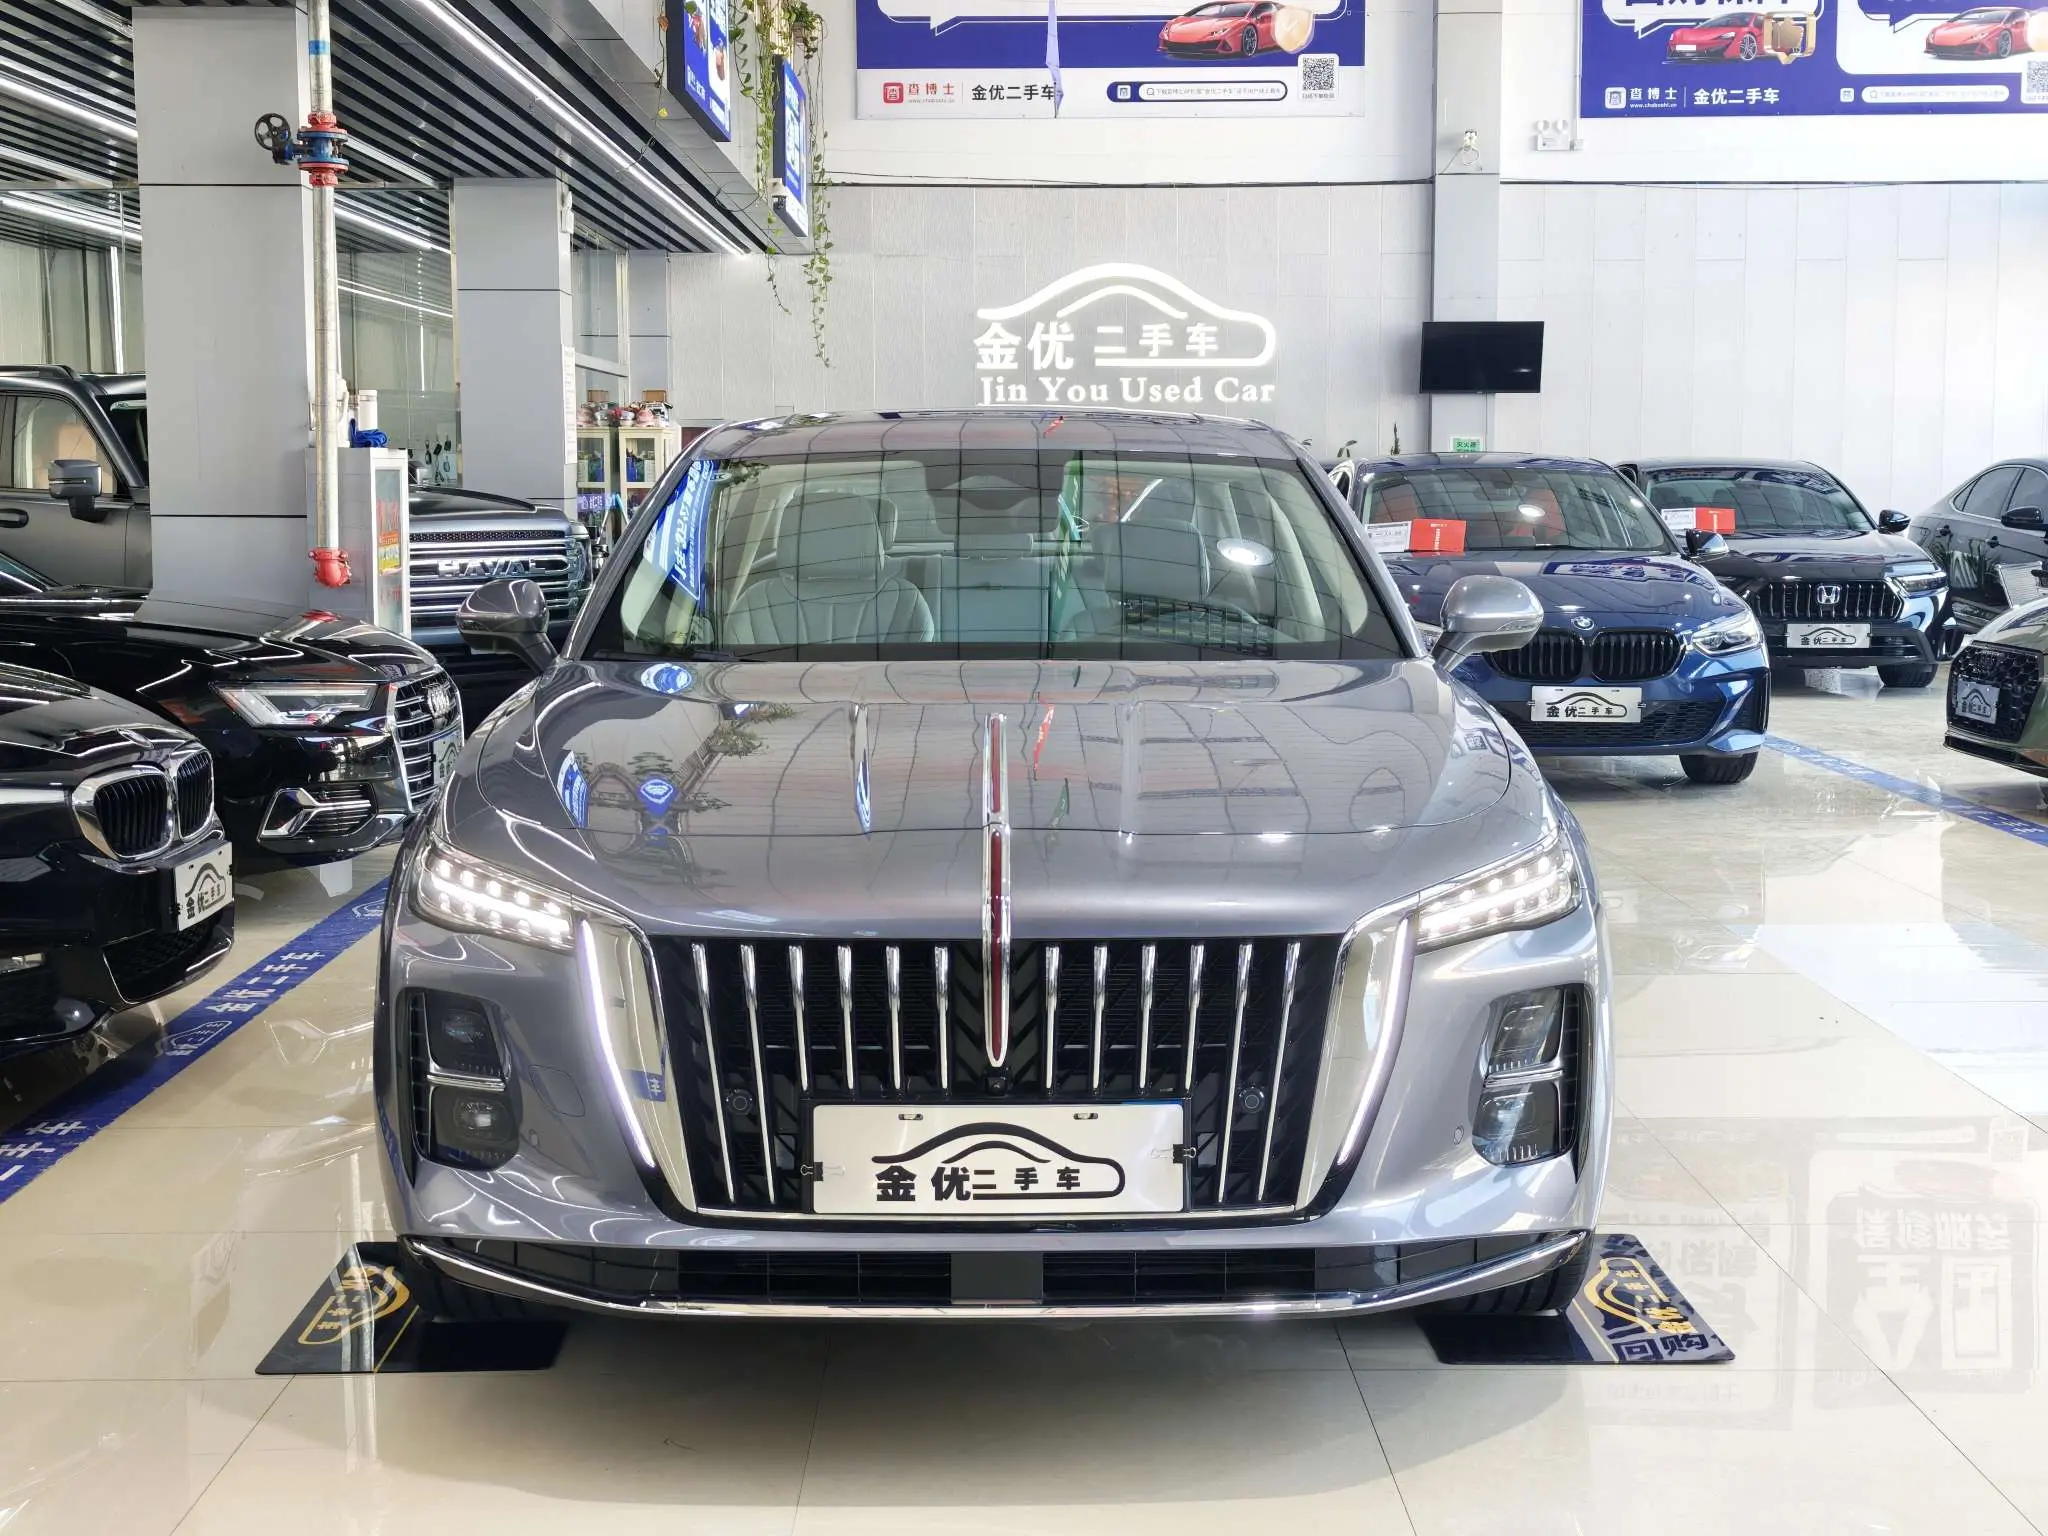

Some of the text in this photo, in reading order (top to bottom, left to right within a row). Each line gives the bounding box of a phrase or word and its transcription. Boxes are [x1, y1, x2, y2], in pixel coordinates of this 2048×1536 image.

[972, 84, 1056, 101] 金优二手车
[1630, 87, 1678, 100] 查博士
[1693, 88, 1780, 105] 金优二手车
[974, 321, 1219, 370] 金优二手车
[980, 376, 1275, 404] Jin You Used Car
[438, 558, 546, 578] HAVAL
[1546, 705, 1613, 718] 金优二手车
[876, 1165, 1082, 1202] 金优二手车
